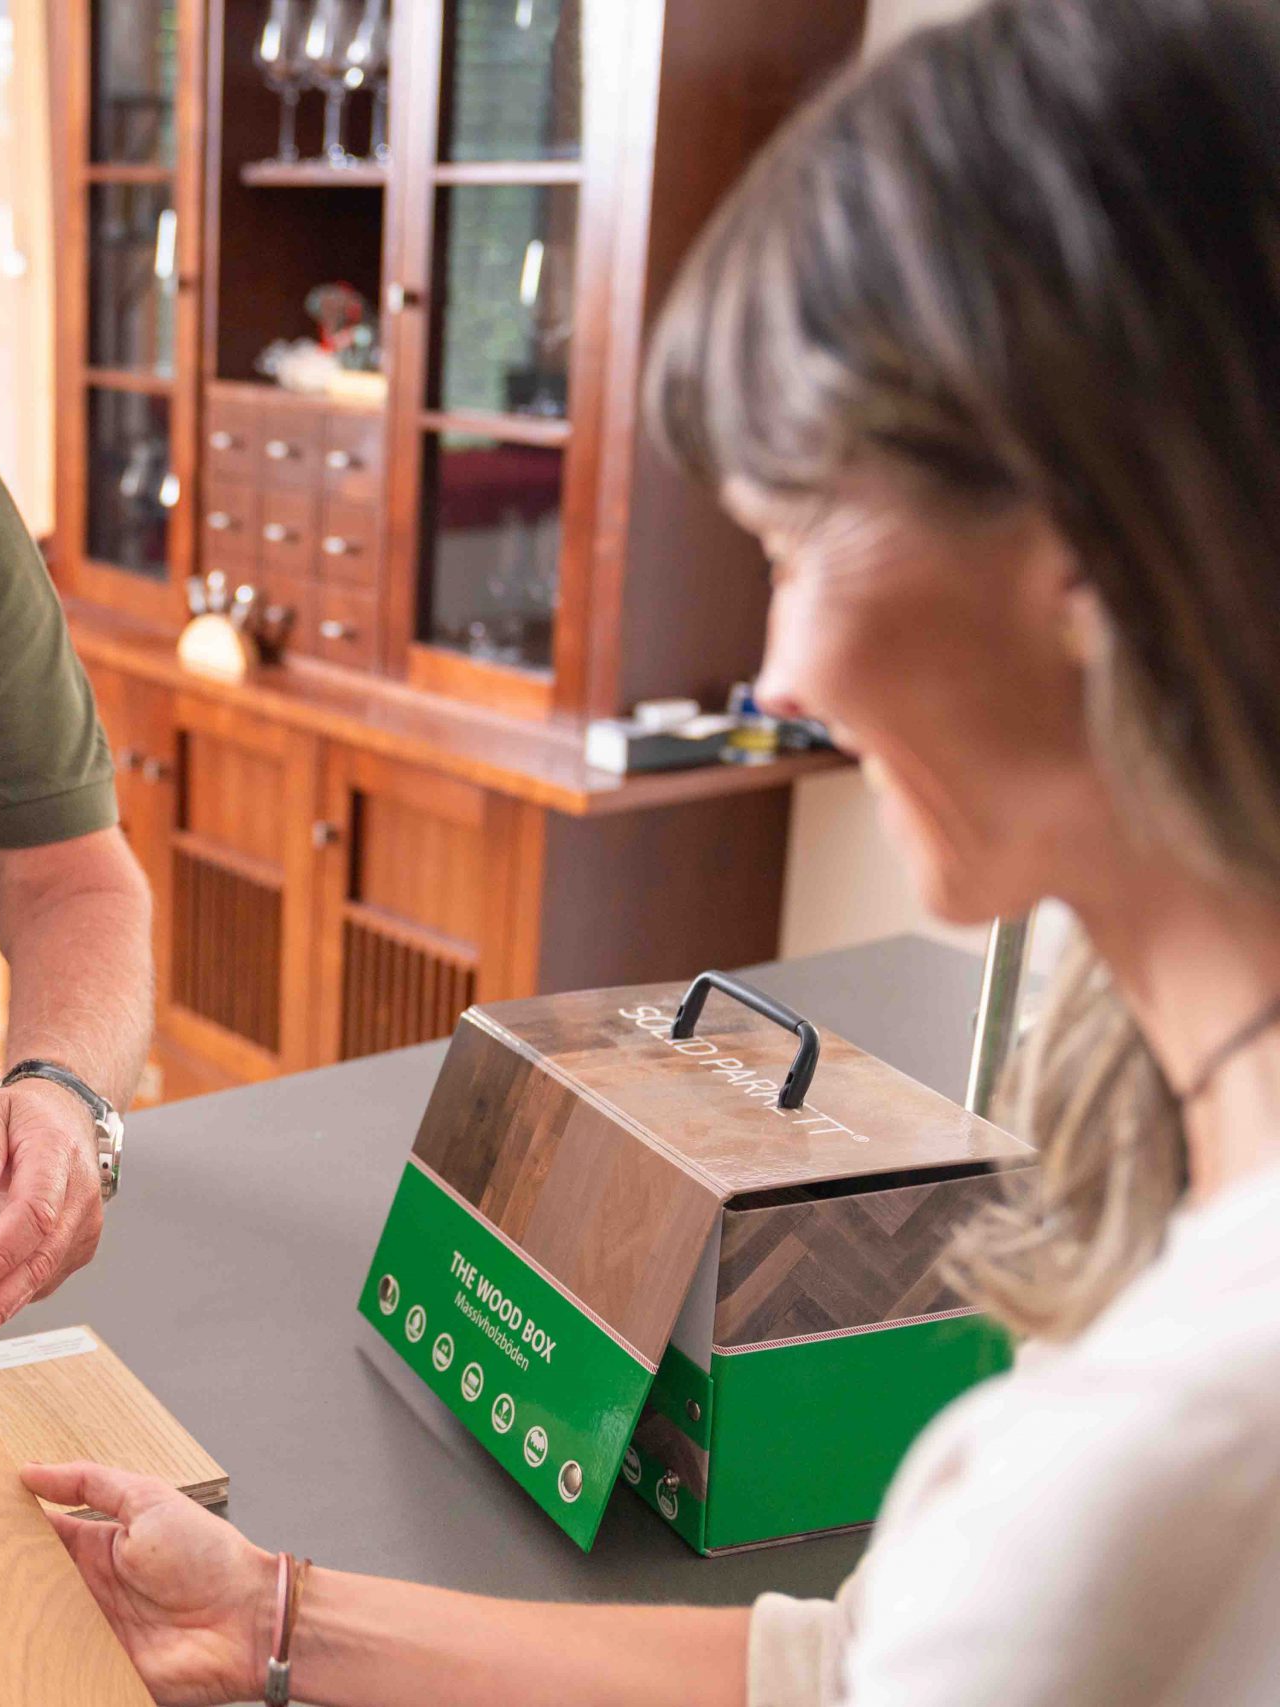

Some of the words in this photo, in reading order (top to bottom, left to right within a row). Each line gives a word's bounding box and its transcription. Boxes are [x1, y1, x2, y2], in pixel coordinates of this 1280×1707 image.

[450, 1250, 478, 1290] THE
[476, 1274, 523, 1331] WOOD
[521, 1318, 557, 1364] BOX
[454, 1290, 530, 1372] Massivholzböden
